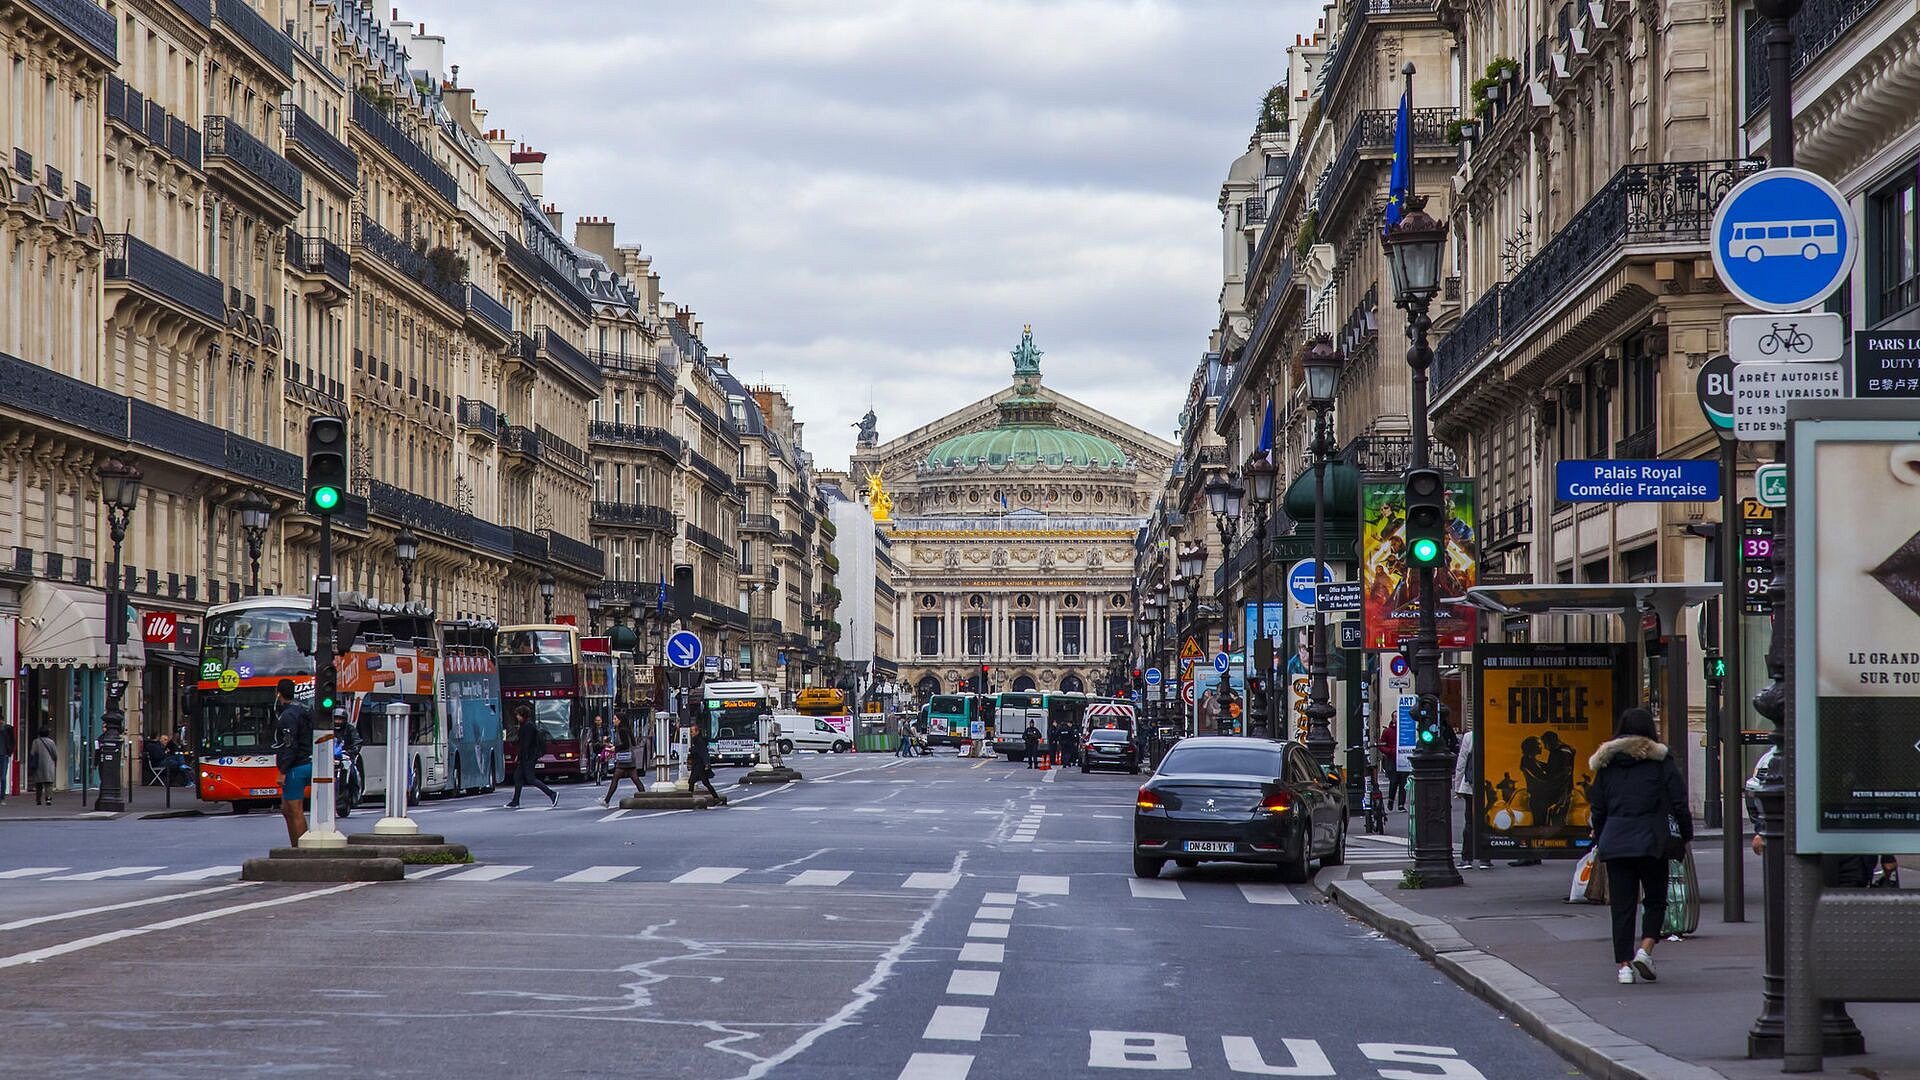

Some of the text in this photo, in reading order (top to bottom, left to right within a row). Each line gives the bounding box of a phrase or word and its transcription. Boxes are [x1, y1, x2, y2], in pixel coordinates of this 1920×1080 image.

[1869, 338, 1905, 350] PARIS
[1881, 358, 1915, 369] DUTY
[1739, 371, 1839, 383] ARRÊT AUTORISÉ
[1739, 388, 1839, 399] POUR LIVRAISON
[1737, 406, 1753, 415] DE
[1738, 422, 1750, 432] ET
[1753, 422, 1767, 432] DE
[1594, 465, 1682, 482] Palais Royal
[1569, 482, 1707, 498] Comédie Française
[1747, 502, 1768, 517] 27
[1747, 540, 1770, 556] 39
[1747, 578, 1769, 594] 95
[147, 617, 175, 640] illy
[1499, 657, 1531, 667] THRILLER
[1848, 652, 1866, 664] LE
[203, 662, 222, 673] 20€
[1860, 672, 1889, 684] SUR
[1824, 811, 1841, 819] Pour
[1087, 1029, 1489, 1080] BUS
